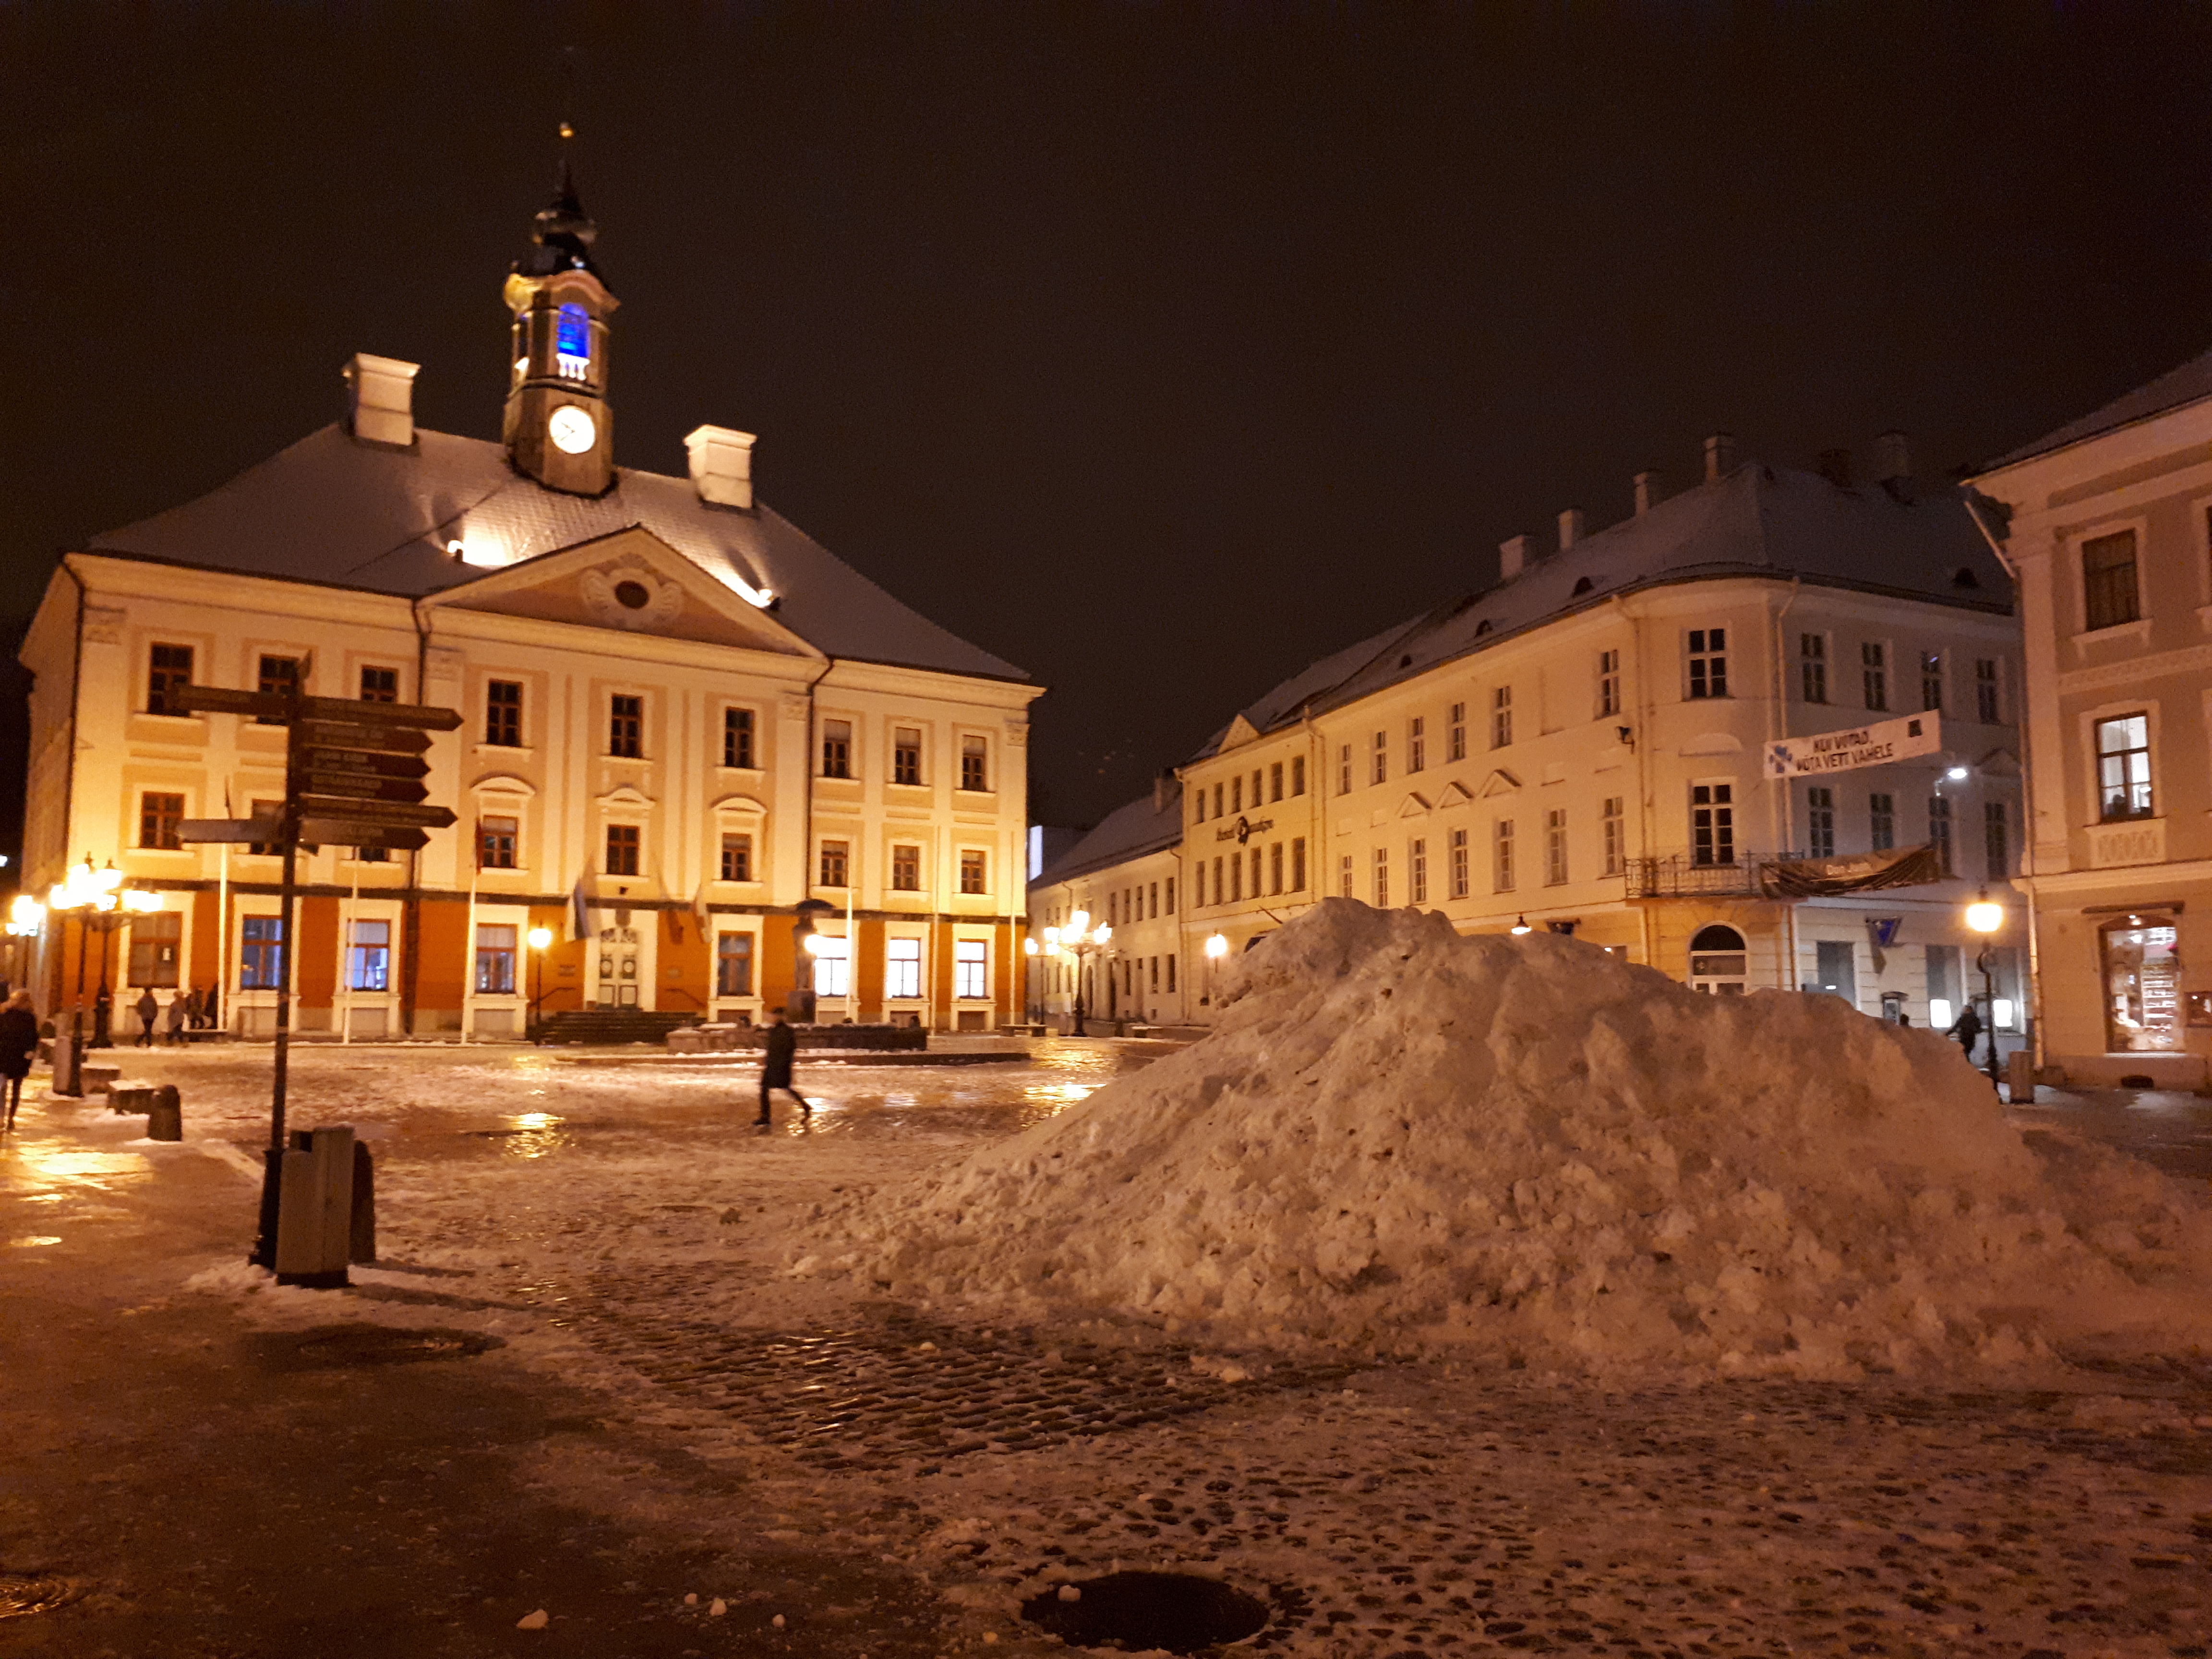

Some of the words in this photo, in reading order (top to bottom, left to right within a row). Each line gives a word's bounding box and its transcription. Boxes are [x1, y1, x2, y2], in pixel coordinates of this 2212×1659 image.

[1813, 738, 1832, 753] KUI
[1823, 751, 1849, 768] VETT
[1850, 741, 1893, 764] VAHELE
